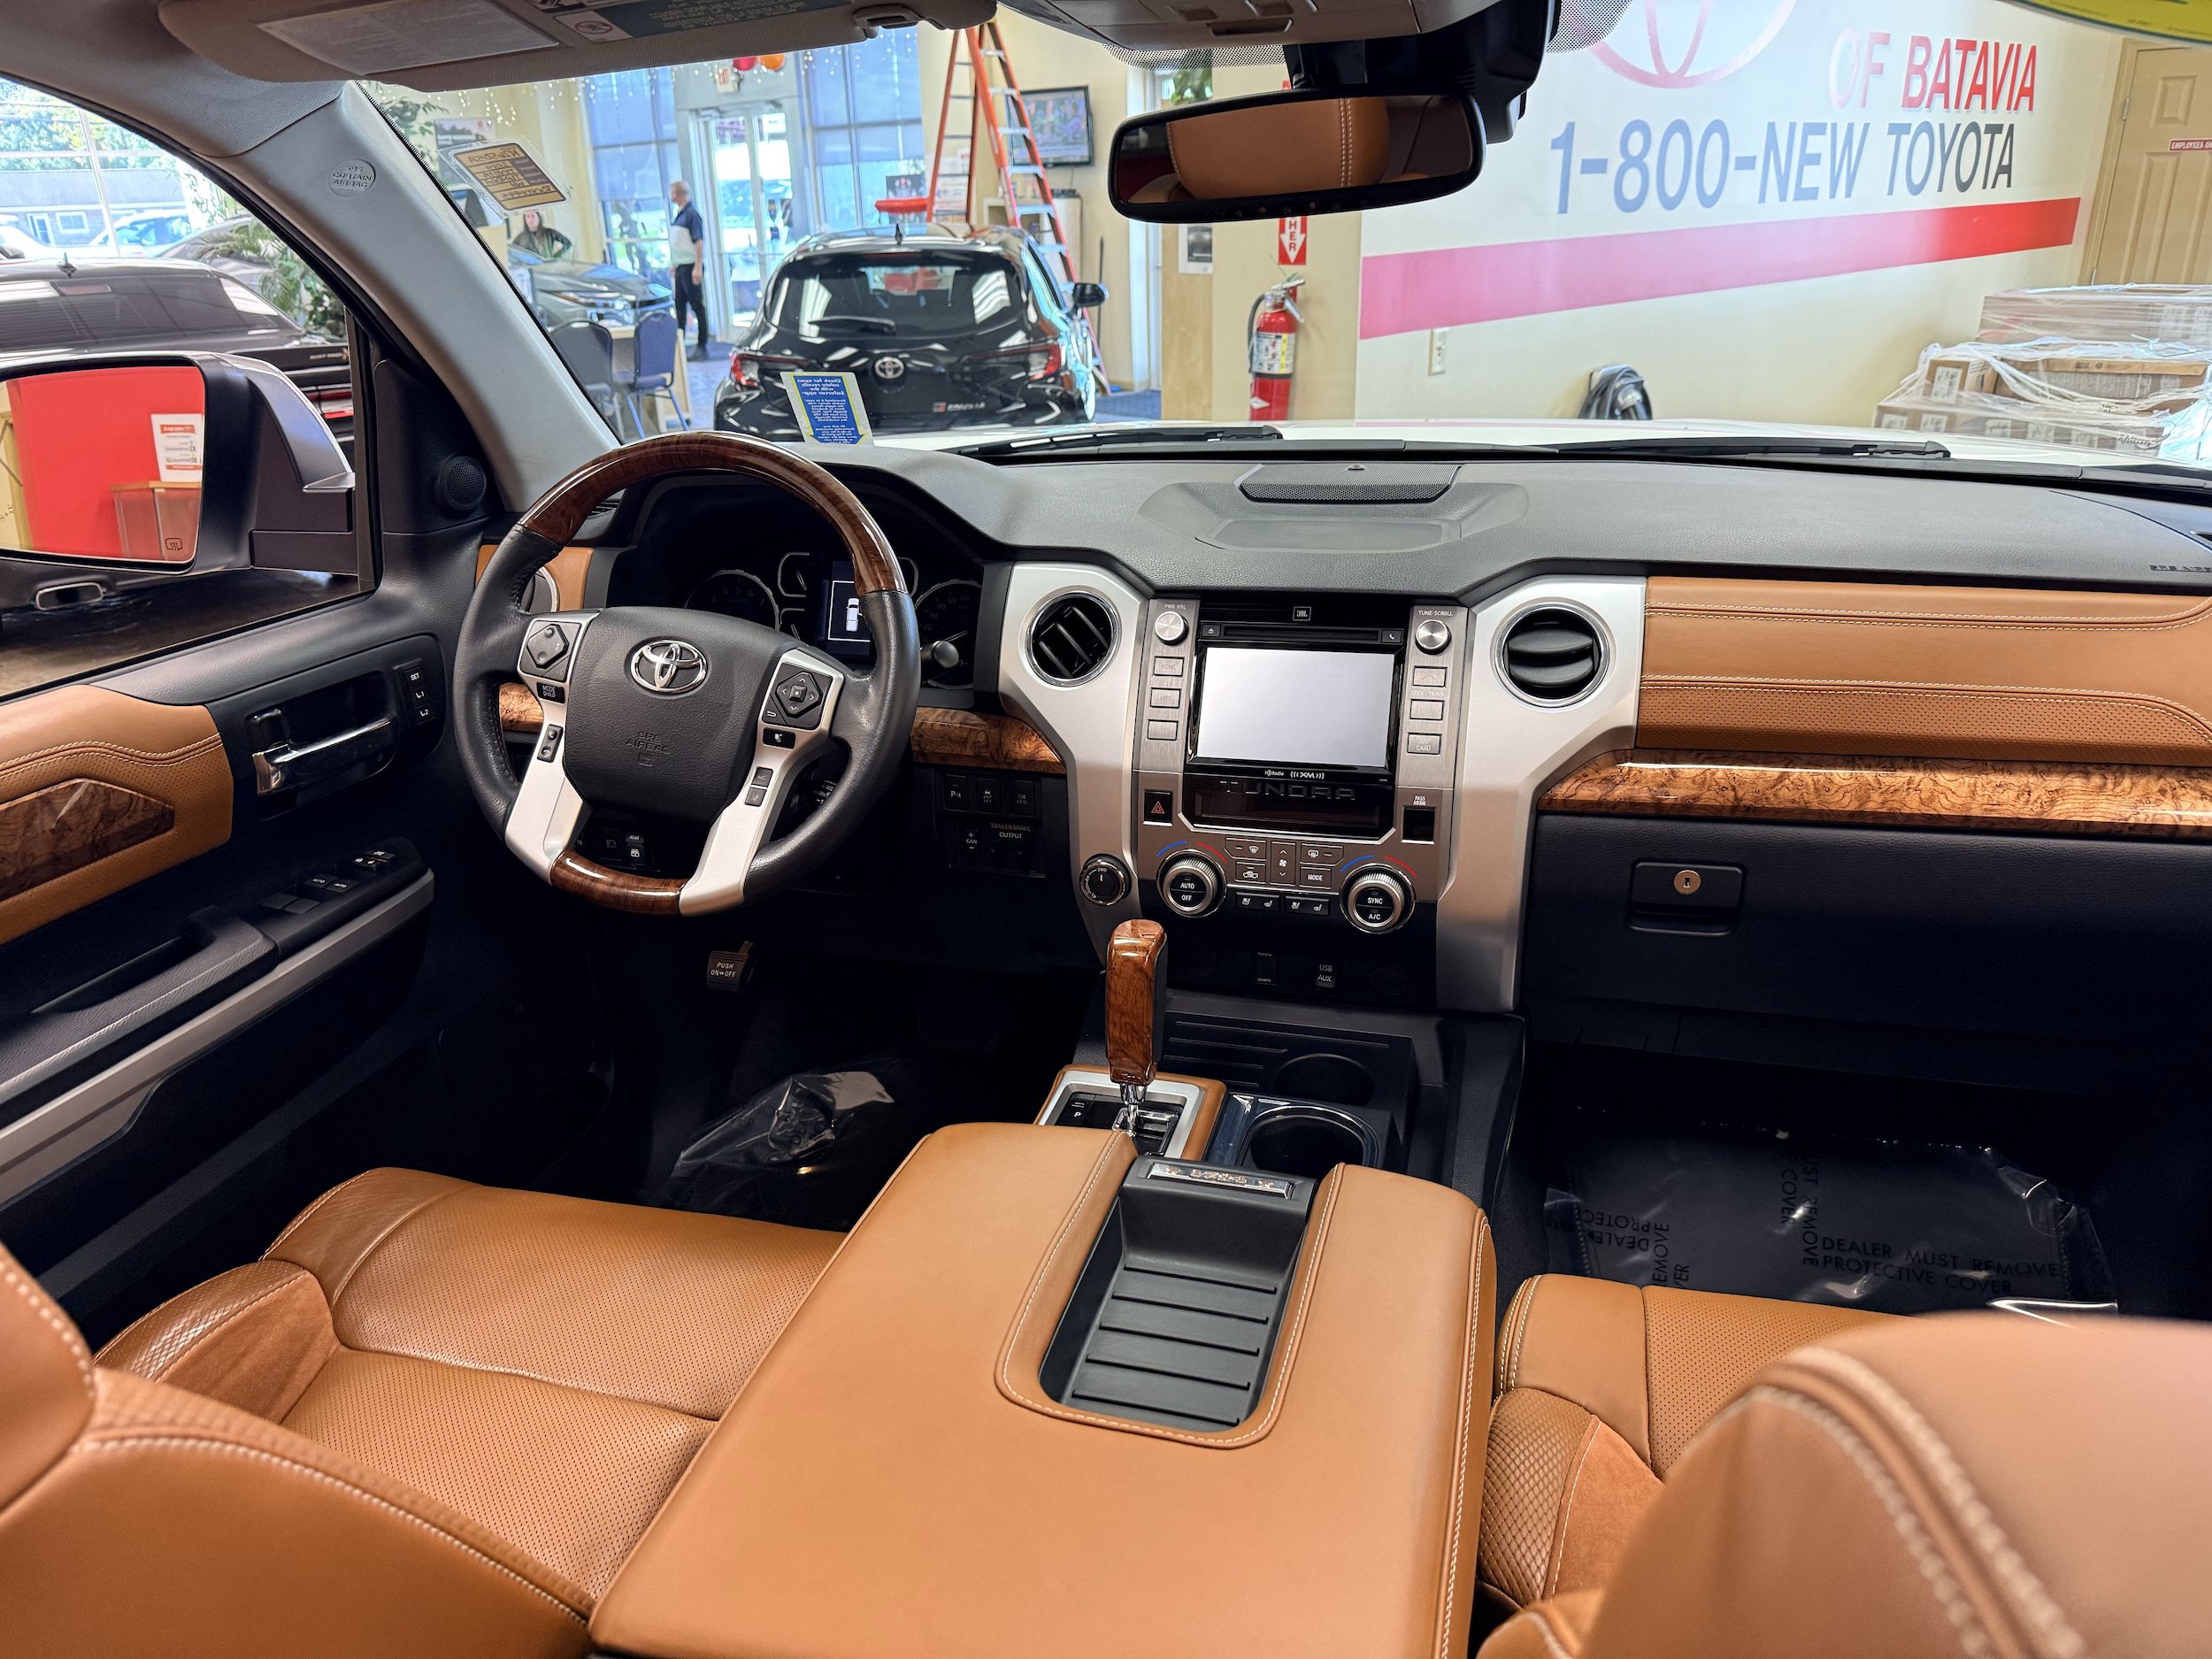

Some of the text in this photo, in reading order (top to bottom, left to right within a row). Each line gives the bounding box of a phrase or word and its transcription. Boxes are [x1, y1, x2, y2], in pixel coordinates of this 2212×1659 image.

[1828, 27, 2037, 111] OF BATAVIA
[333, 173, 372, 181] CURTAIN
[1550, 119, 2016, 215] 1-800-NEW TOYOTA
[410, 672, 420, 681] SET
[626, 738, 671, 755] AIRBAG
[1317, 974, 1332, 983] AUX
[1319, 964, 1333, 972] USB
[1652, 1223, 1670, 1285] EMOVE
[1823, 1237, 2061, 1278] DEALER MUST REMOVE
[1823, 1255, 2012, 1294] PROTECTIVE COVER
